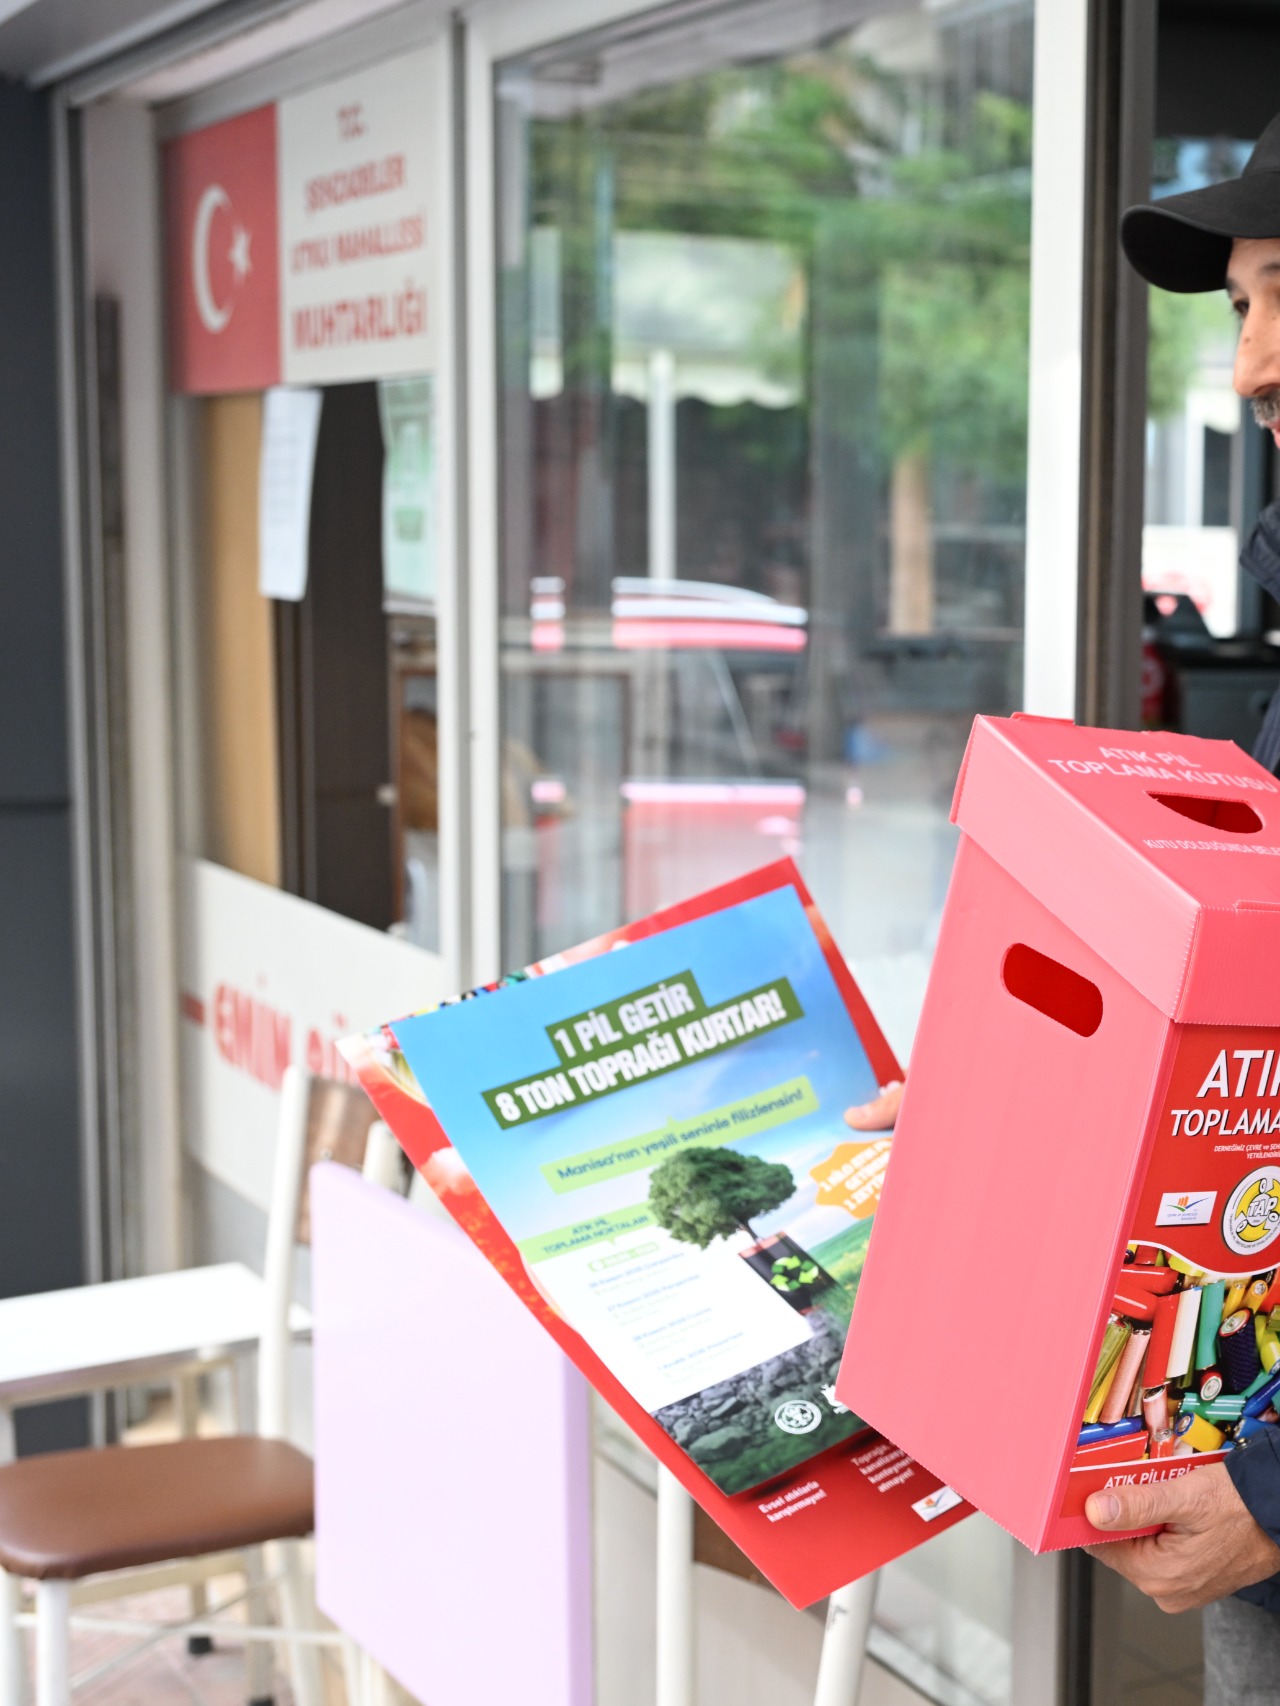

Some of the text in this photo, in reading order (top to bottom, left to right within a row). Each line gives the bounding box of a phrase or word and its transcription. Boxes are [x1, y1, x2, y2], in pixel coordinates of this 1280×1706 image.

[1098, 746, 1201, 768] ATIK PİL
[1048, 759, 1279, 793] TOPLAMA KUTUSU
[1142, 839, 1177, 849] KUTU
[554, 982, 696, 1059] 1 PİL GETİR
[494, 988, 787, 1122] 8 TON TOPRAĞI KURTAR!
[556, 1149, 641, 1181] Manisa'nın
[642, 1133, 679, 1157] yeşili
[680, 1117, 730, 1142] seninle
[1246, 1143, 1263, 1153] ÇEVRE
[1247, 1196, 1279, 1218] TAP
[1103, 1473, 1138, 1490] ATIK
[757, 1495, 786, 1514] Evsel
